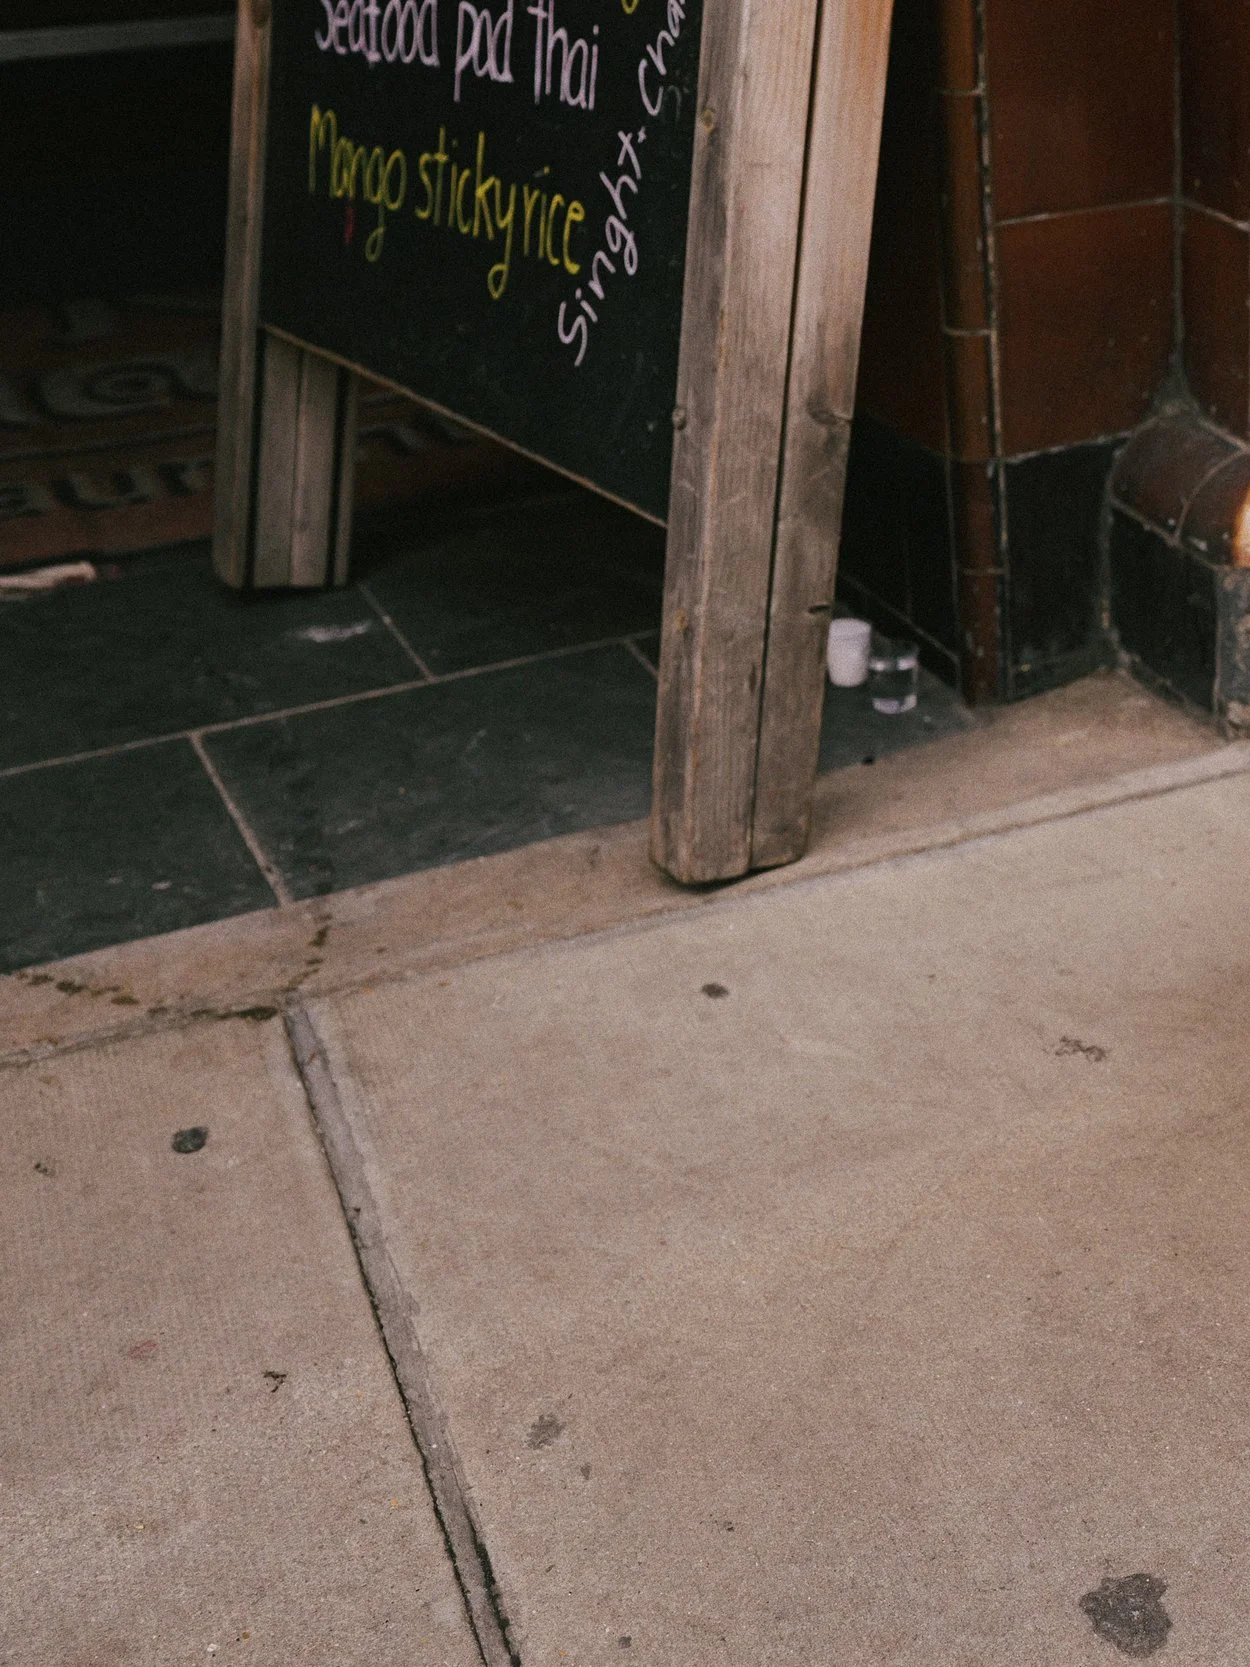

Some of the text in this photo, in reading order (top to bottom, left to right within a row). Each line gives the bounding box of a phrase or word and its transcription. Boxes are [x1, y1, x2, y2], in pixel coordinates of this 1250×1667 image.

[453, 0, 514, 102] pad
[528, 0, 600, 111] thai
[308, 103, 585, 300] Mango sticky rice
